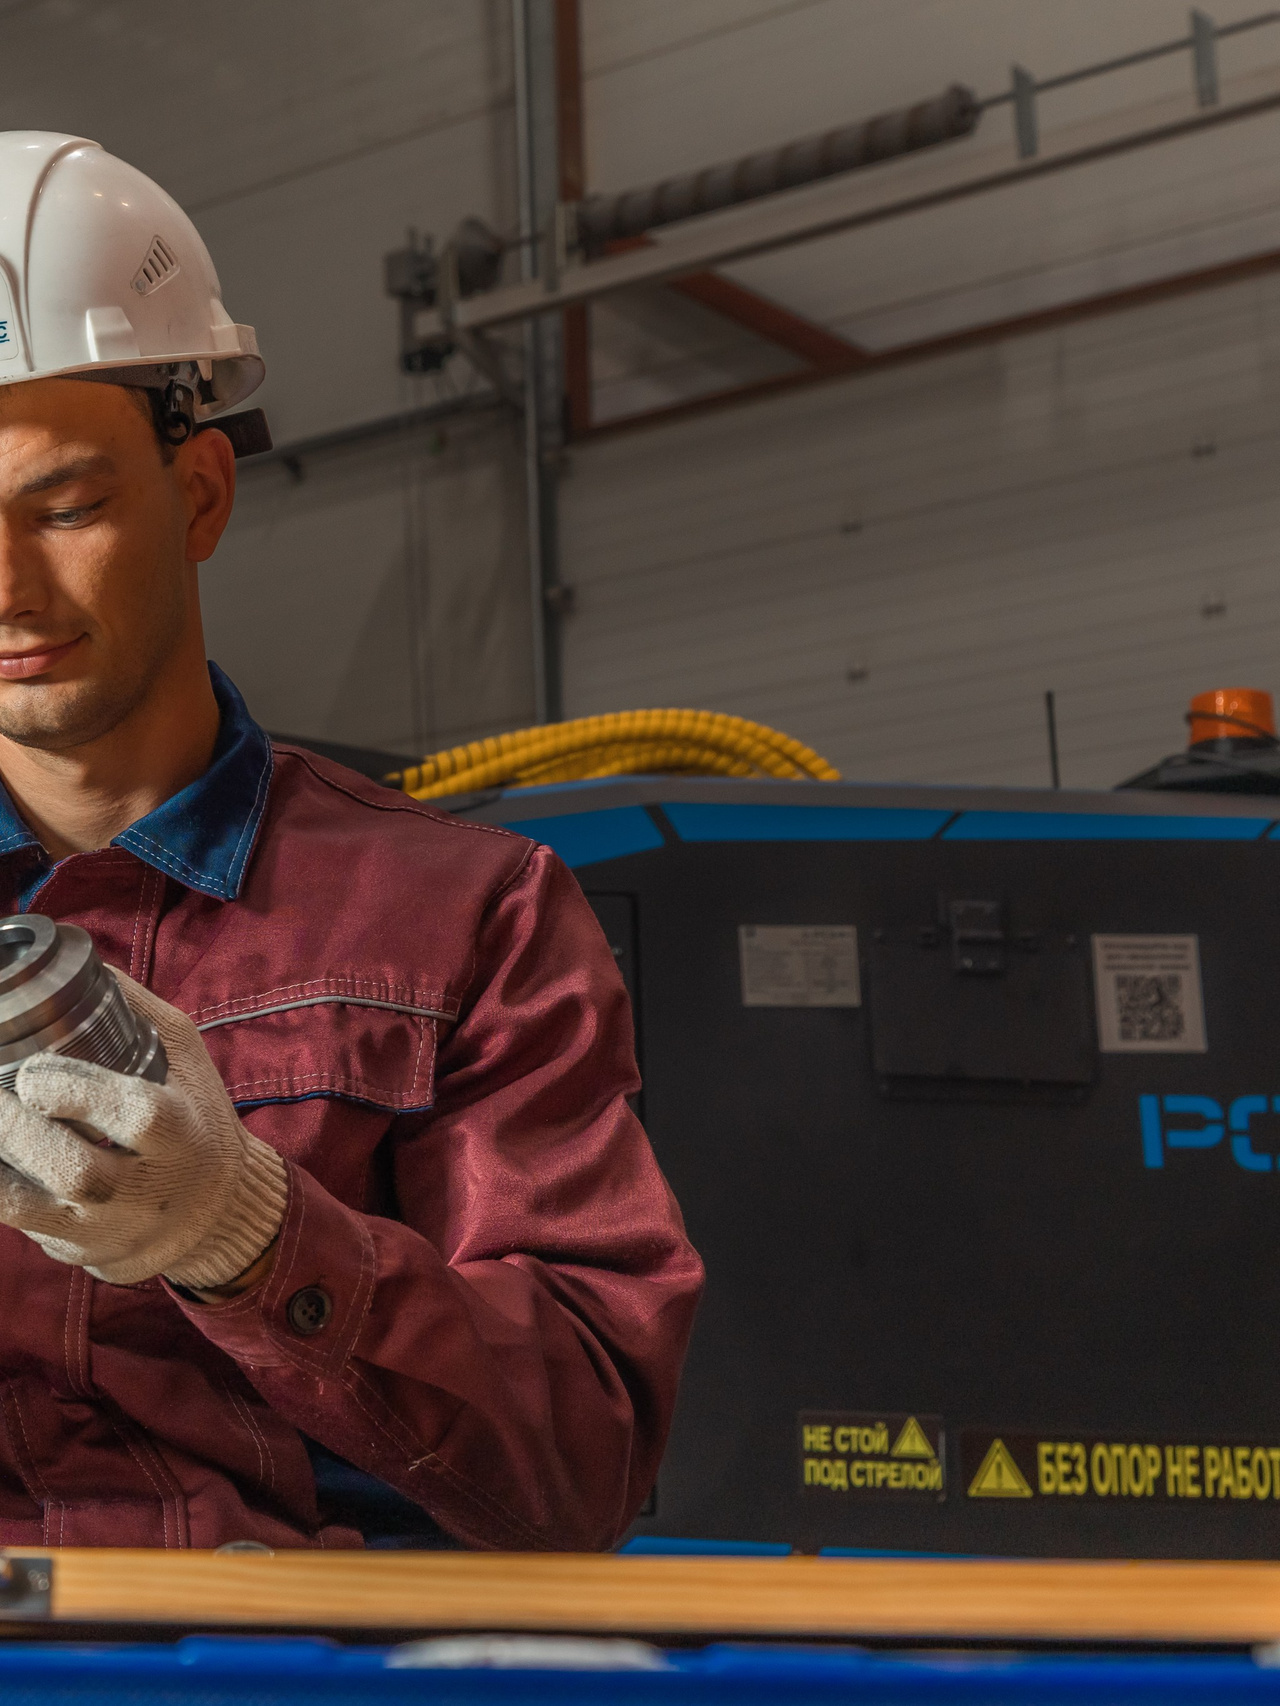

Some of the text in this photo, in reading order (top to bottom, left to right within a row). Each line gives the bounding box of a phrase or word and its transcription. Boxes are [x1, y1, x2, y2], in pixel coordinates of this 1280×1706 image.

[803, 1421, 889, 1454] НЕ СТОЙ
[804, 1457, 943, 1491] ПОД СТРЕЛОЙ
[1037, 1441, 1087, 1497] БЕЗ
[1091, 1443, 1162, 1497] ОПОР
[1165, 1444, 1202, 1498] НЕ
